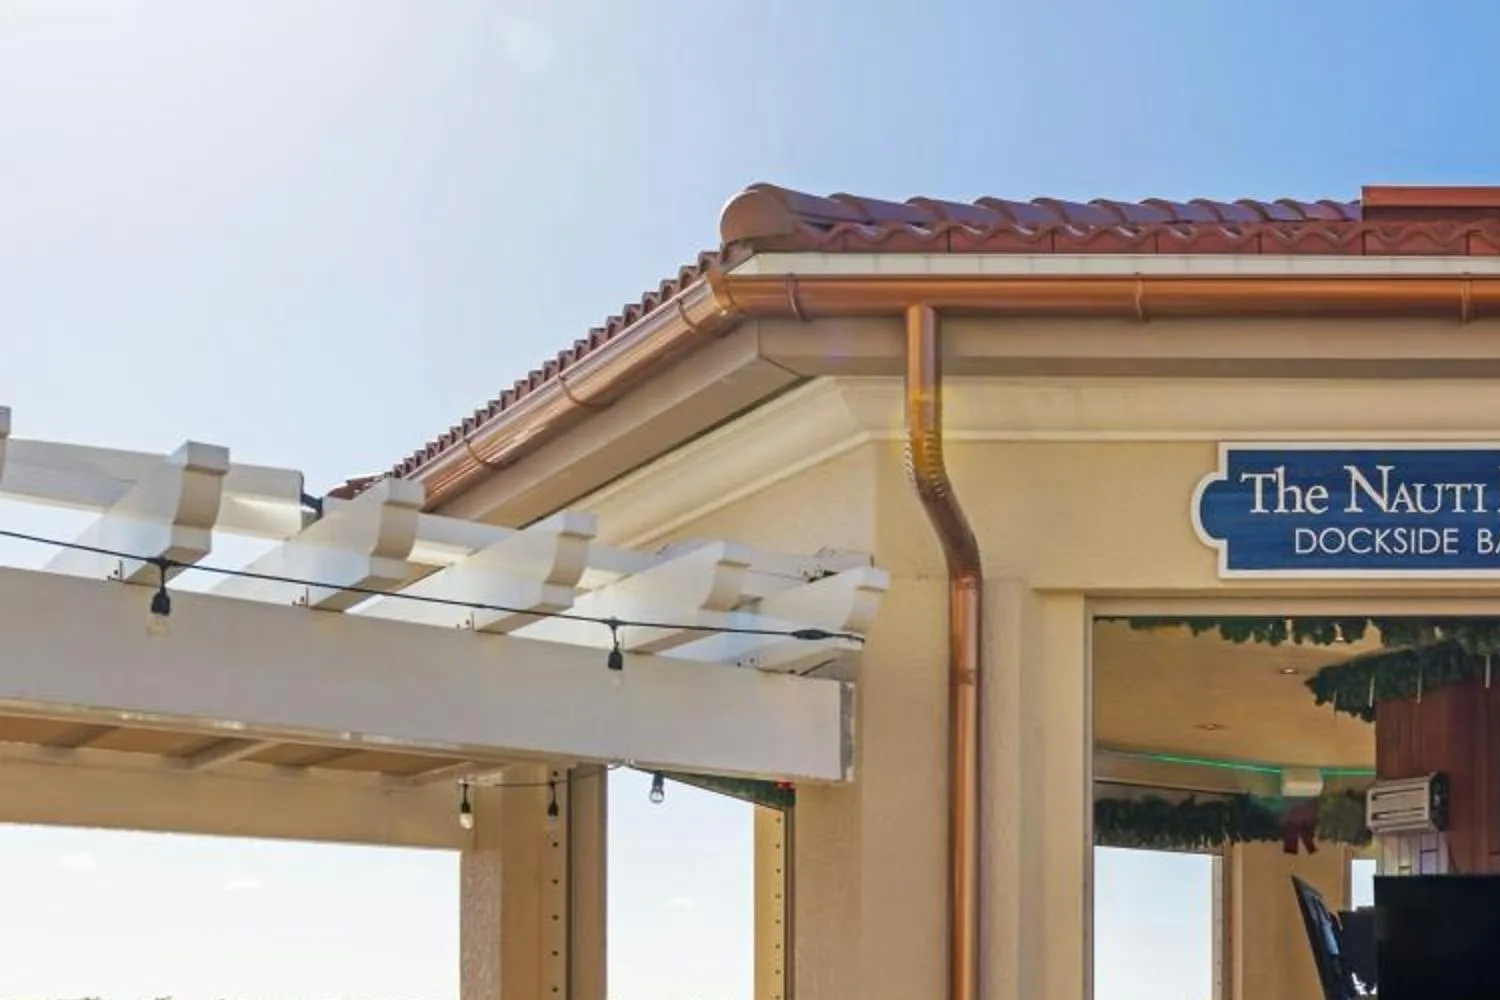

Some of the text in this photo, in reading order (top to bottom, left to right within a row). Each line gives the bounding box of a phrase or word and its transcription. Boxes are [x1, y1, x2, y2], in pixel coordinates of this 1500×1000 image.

[1240, 465, 1329, 514] The
[1343, 465, 1487, 514] NAUTI
[1295, 527, 1458, 554] DOCKSIDE
